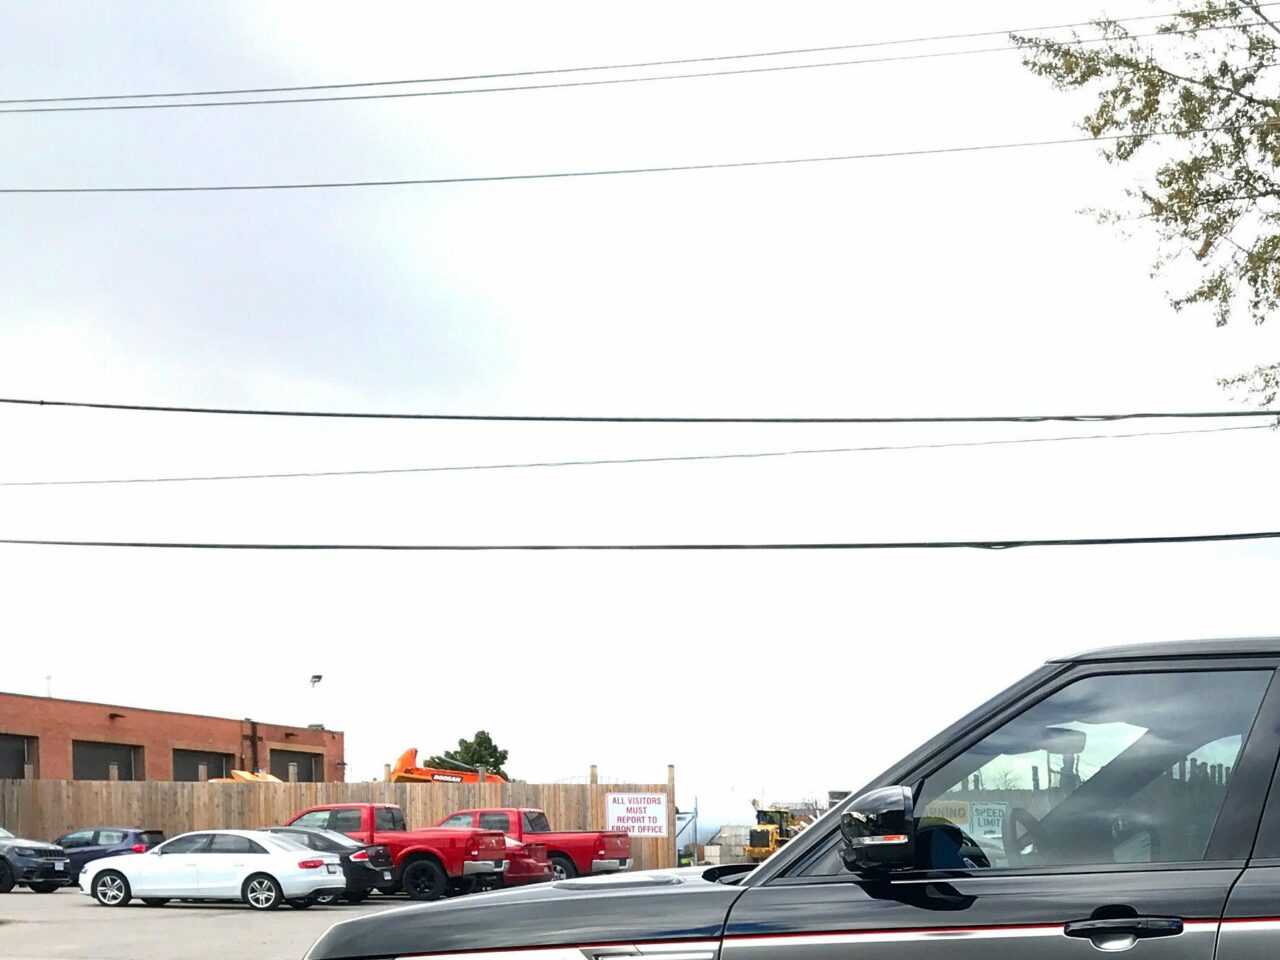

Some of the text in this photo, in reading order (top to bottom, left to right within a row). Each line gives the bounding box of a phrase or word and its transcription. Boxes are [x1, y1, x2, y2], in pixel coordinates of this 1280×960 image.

[612, 797, 662, 805] ALL VISITORS
[626, 806, 647, 814] MUST
[974, 808, 1005, 818] SPEED
[616, 816, 658, 824] REPORT TO
[977, 817, 1001, 828] LIMIT
